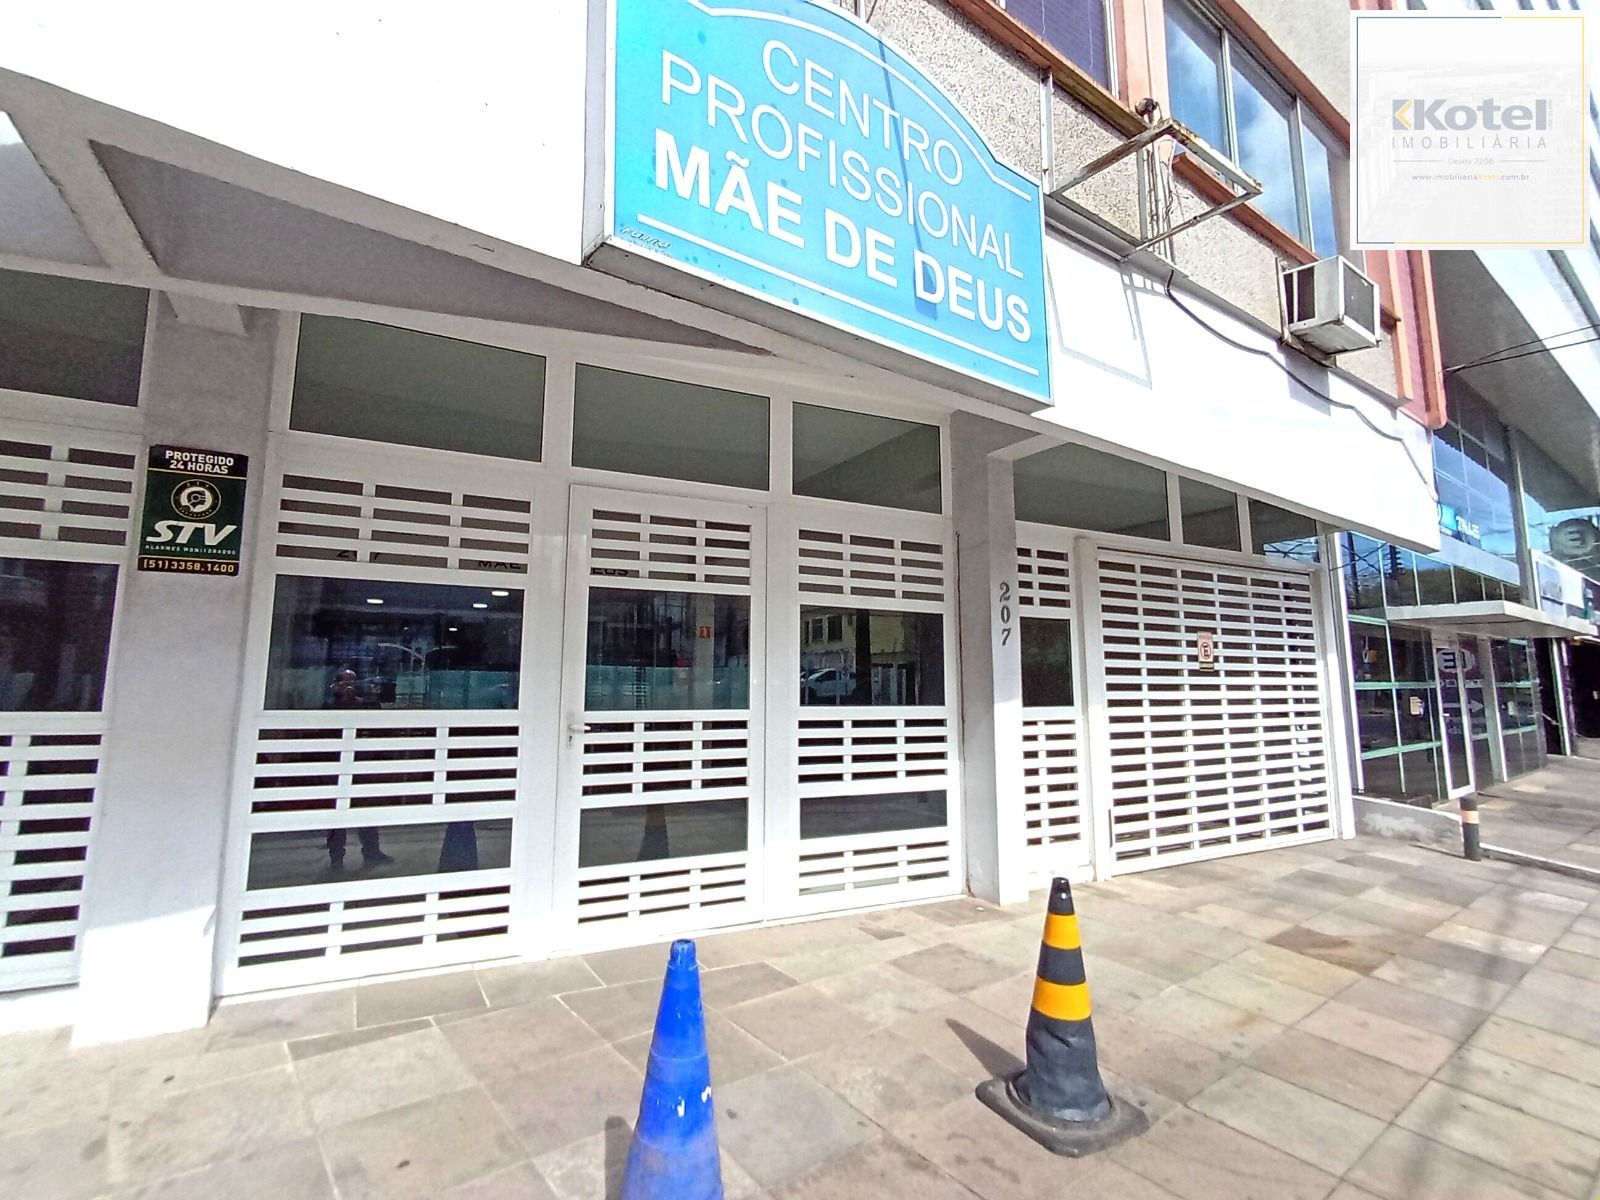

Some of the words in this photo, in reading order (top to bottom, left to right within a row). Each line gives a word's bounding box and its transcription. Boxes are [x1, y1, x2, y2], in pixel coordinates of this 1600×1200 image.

[762, 39, 965, 187] CENTRO
[661, 48, 1025, 280] PROFISSIONAL
[654, 127, 806, 249] MÃE
[825, 207, 899, 289] DE
[913, 248, 1032, 343] DEUS
[165, 450, 235, 467] PROTEGIDO
[169, 460, 185, 470] 24
[187, 461, 229, 475] HORAS
[145, 520, 238, 546] STV
[999, 581, 1012, 647] 207
